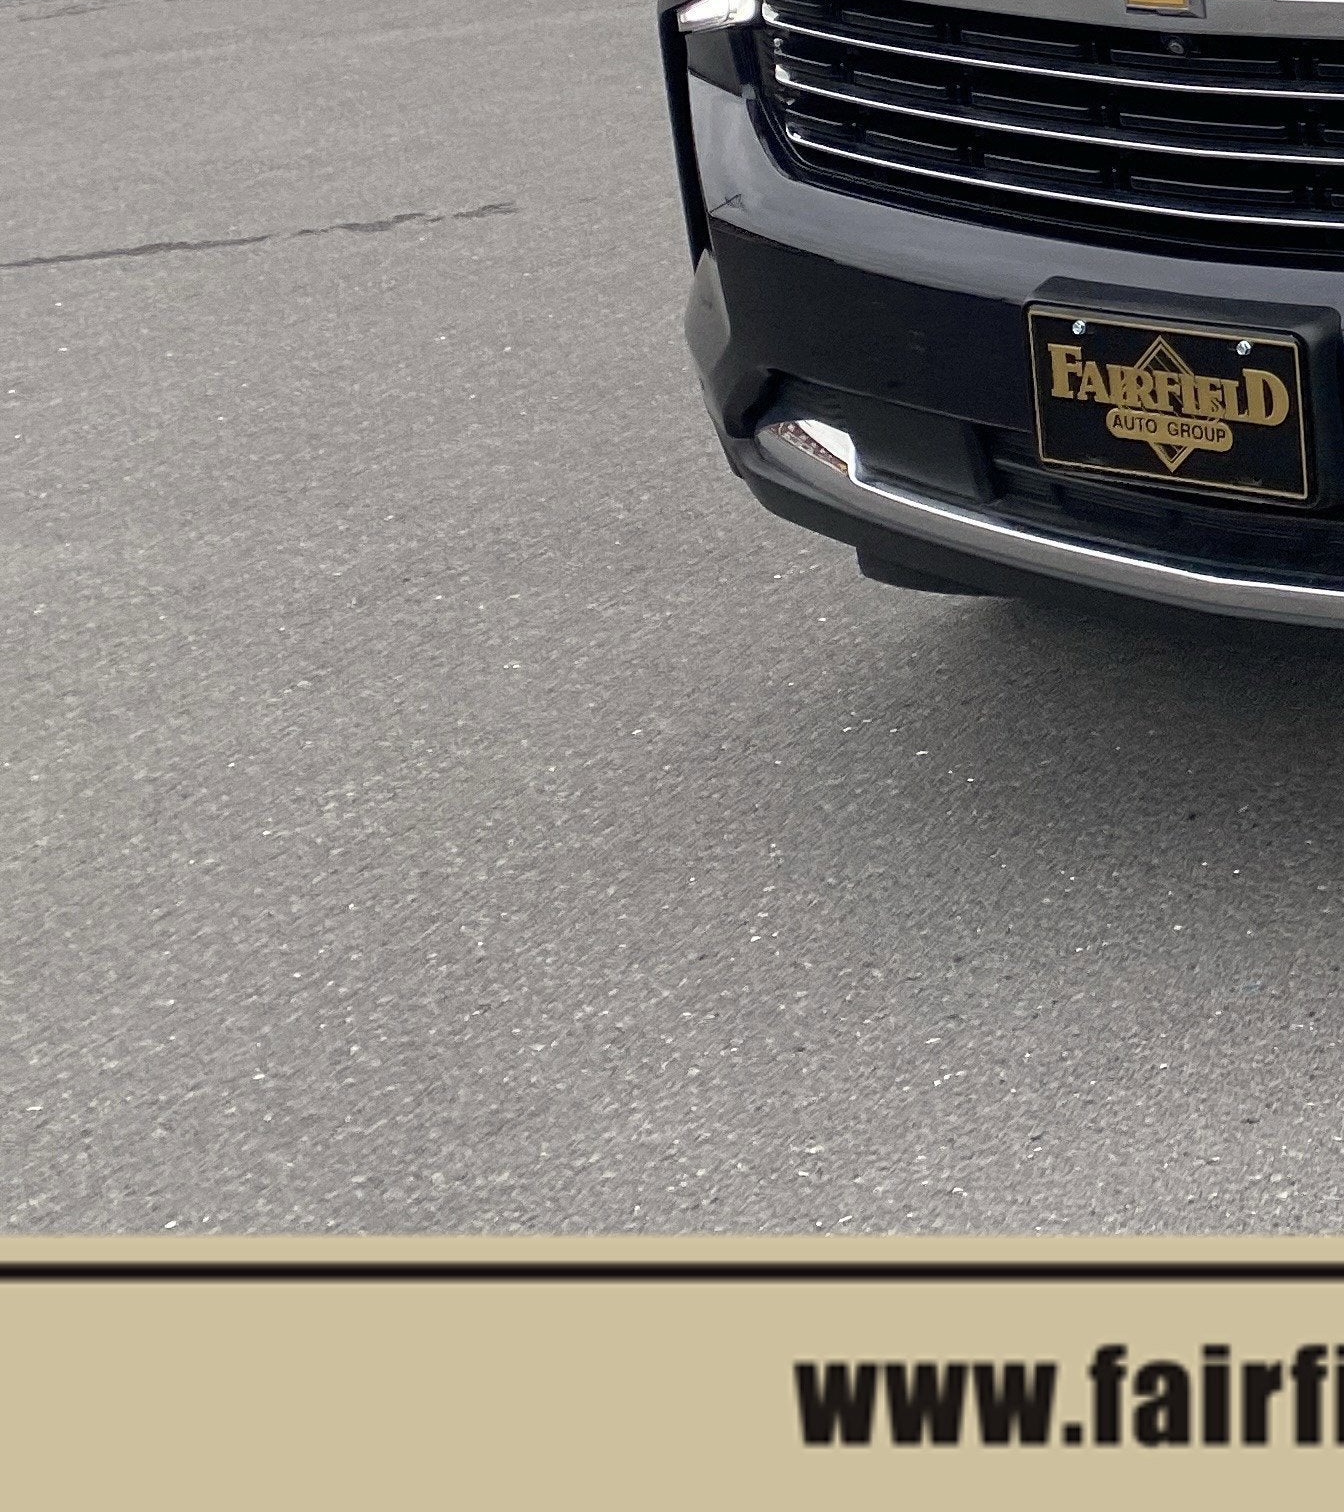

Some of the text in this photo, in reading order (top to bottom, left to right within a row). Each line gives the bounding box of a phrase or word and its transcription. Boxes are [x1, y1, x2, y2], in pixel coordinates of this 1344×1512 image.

[1047, 343, 1290, 426] FAIRFIELD
[1112, 414, 1226, 443] AUTO GROUP
